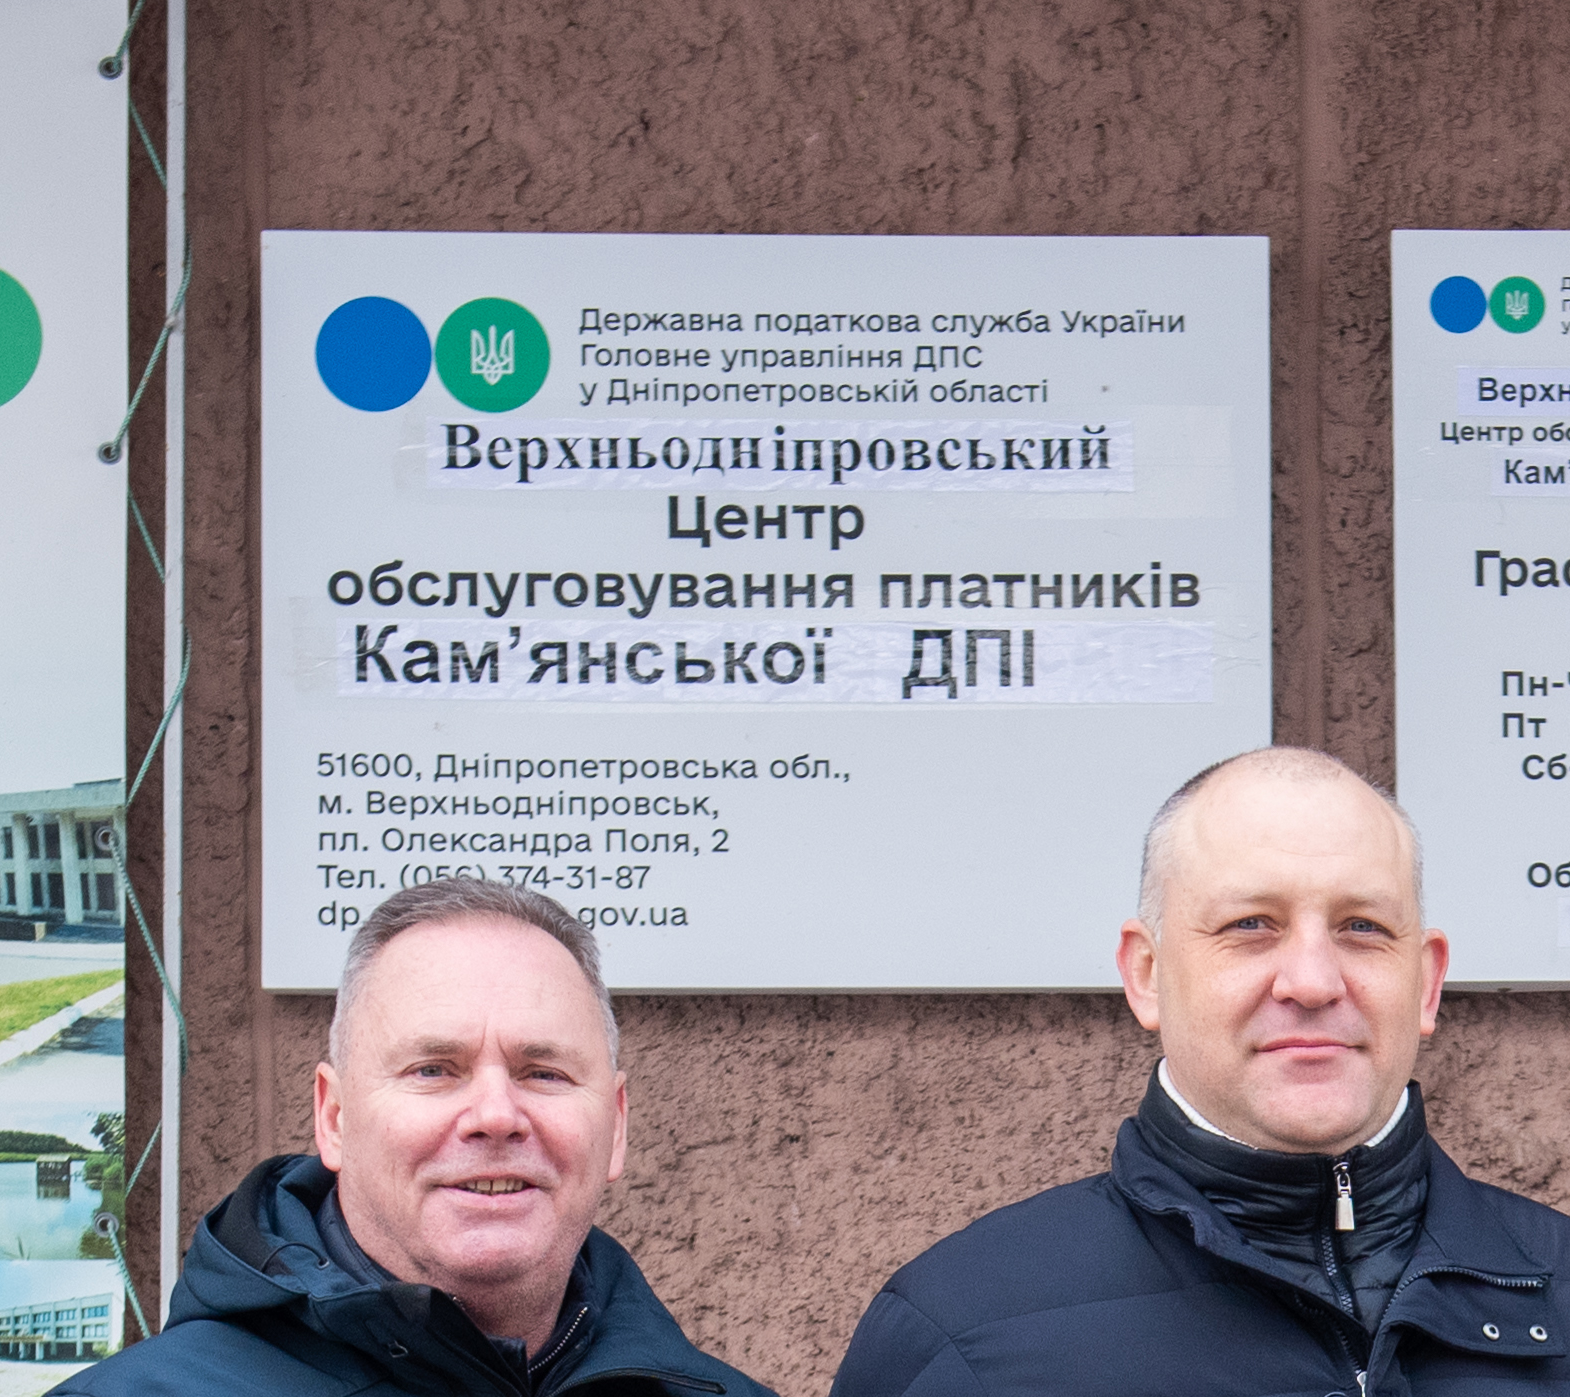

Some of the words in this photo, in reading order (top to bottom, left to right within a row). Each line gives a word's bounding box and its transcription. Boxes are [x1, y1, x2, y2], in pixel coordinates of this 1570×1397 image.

[579, 308, 743, 336] Державна
[755, 314, 921, 335] податкова
[932, 310, 1051, 338] служба
[1061, 310, 1184, 338] України
[1561, 322, 1570, 335] у
[582, 344, 710, 367] Головне
[721, 345, 902, 373] управління
[914, 346, 982, 372] ДПС
[580, 383, 597, 406] у
[607, 378, 918, 407] Дніпропетровській
[930, 379, 1047, 403] області
[1441, 422, 1523, 445] Центр
[444, 424, 1109, 484] Верхньодніпровський
[669, 496, 864, 550] Центр
[328, 560, 853, 619] обслуговування
[881, 562, 1199, 608] платників
[902, 630, 1034, 699] ДПІ
[1503, 713, 1546, 738] Пт
[318, 753, 421, 781] 51600,
[434, 753, 758, 784] Дніпропетровська
[770, 754, 849, 782] обл.,
[319, 795, 352, 814] м.
[367, 791, 718, 821] Верхньодніпровськ,
[319, 832, 368, 851] пл.
[382, 828, 592, 858] Олександра
[606, 829, 699, 856] Поля,
[712, 829, 729, 852] 2
[318, 865, 385, 889] Тел.
[499, 866, 650, 890] 374-31-87
